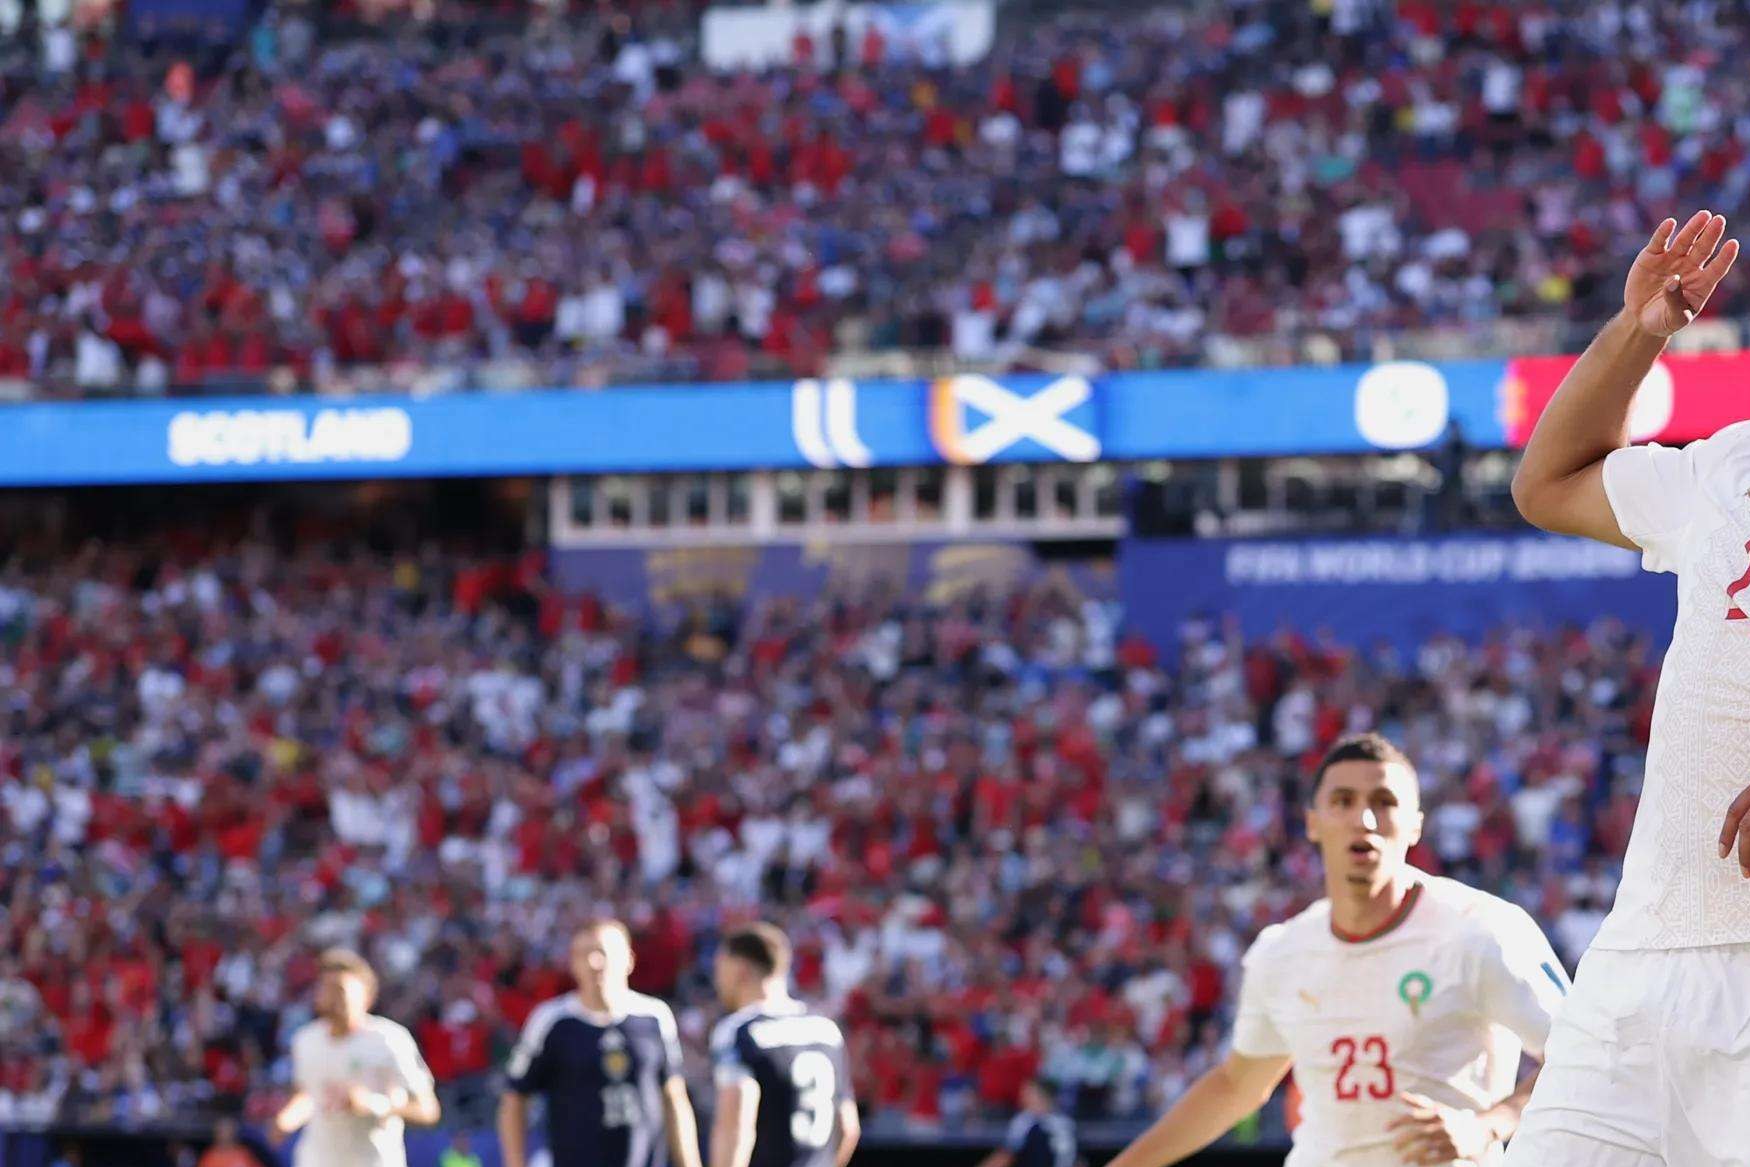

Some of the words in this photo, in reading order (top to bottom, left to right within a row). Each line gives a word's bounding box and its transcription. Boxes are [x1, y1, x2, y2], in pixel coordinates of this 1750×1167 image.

[168, 408, 411, 464] SCOTLAND
[791, 1050, 836, 1147] 3
[1330, 1034, 1395, 1101] 23
